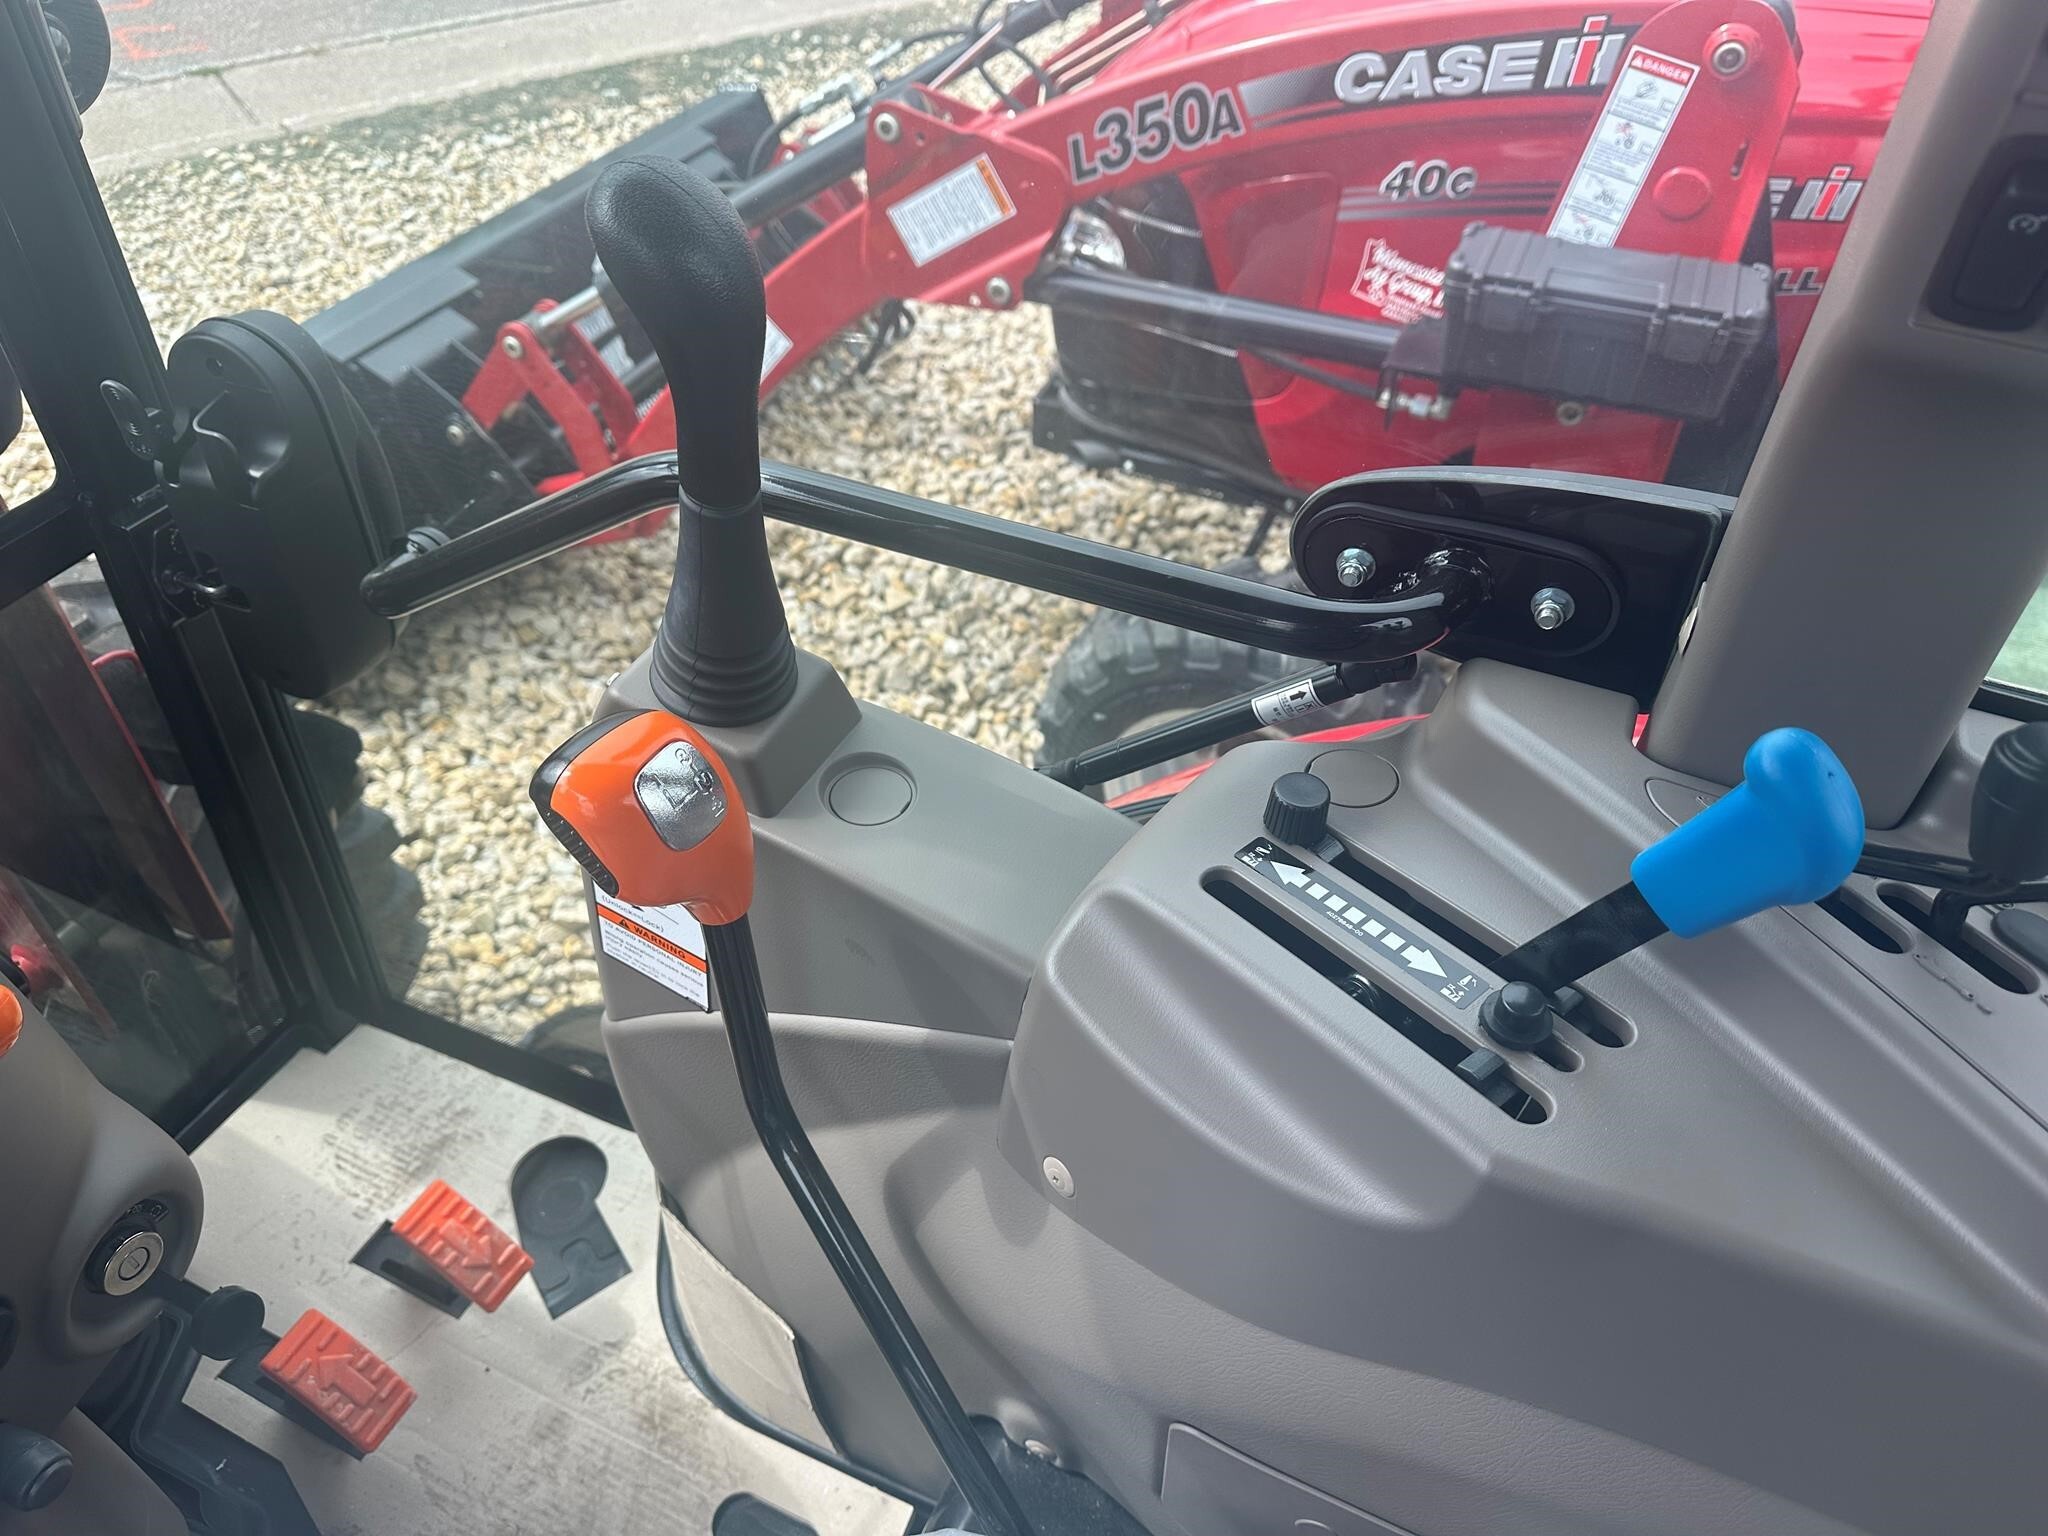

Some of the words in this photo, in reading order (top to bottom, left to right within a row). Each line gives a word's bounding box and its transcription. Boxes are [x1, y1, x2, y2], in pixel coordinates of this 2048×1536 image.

[1334, 40, 1544, 103] CASE
[1643, 57, 1692, 82] DANGER
[1067, 82, 1246, 185] L350A
[634, 925, 686, 959] WARNING
